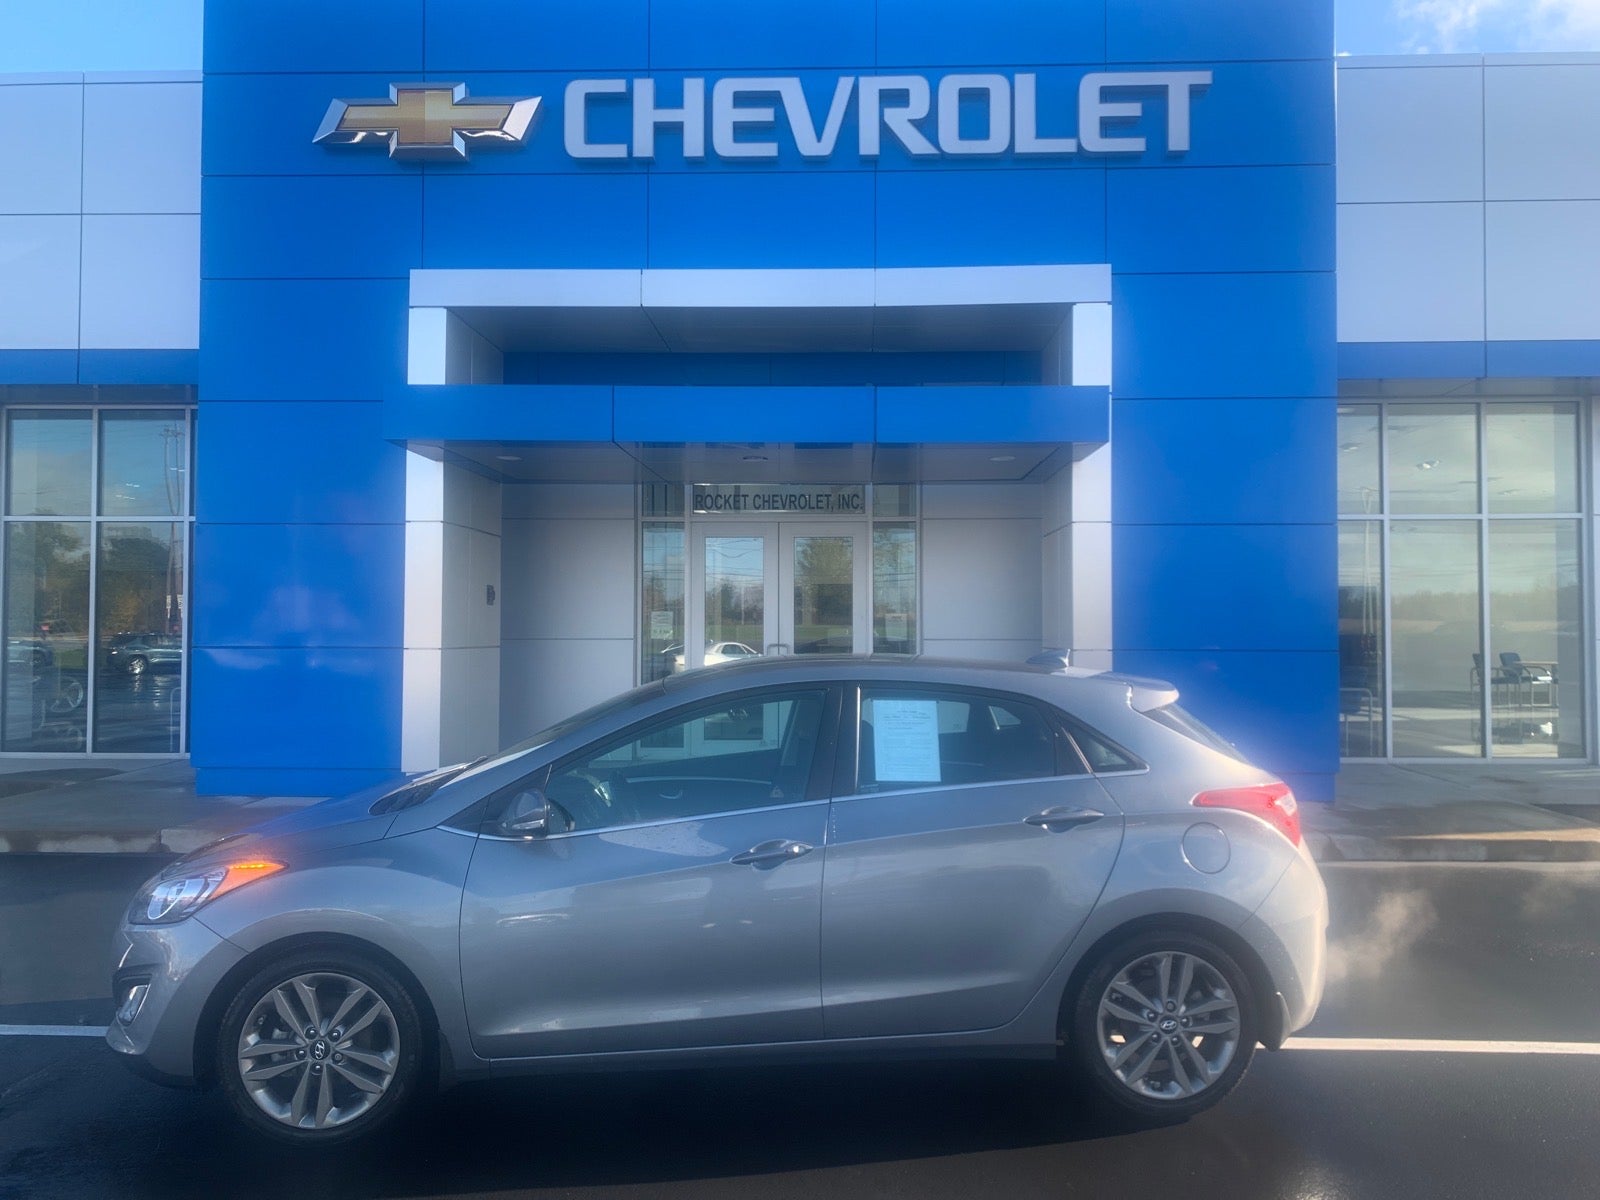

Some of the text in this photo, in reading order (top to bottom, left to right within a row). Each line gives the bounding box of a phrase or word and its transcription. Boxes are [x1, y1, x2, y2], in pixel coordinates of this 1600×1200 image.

[564, 71, 1213, 158] CHEVROLET
[695, 494, 863, 512] ROCKET CHEVROLET, INC.
